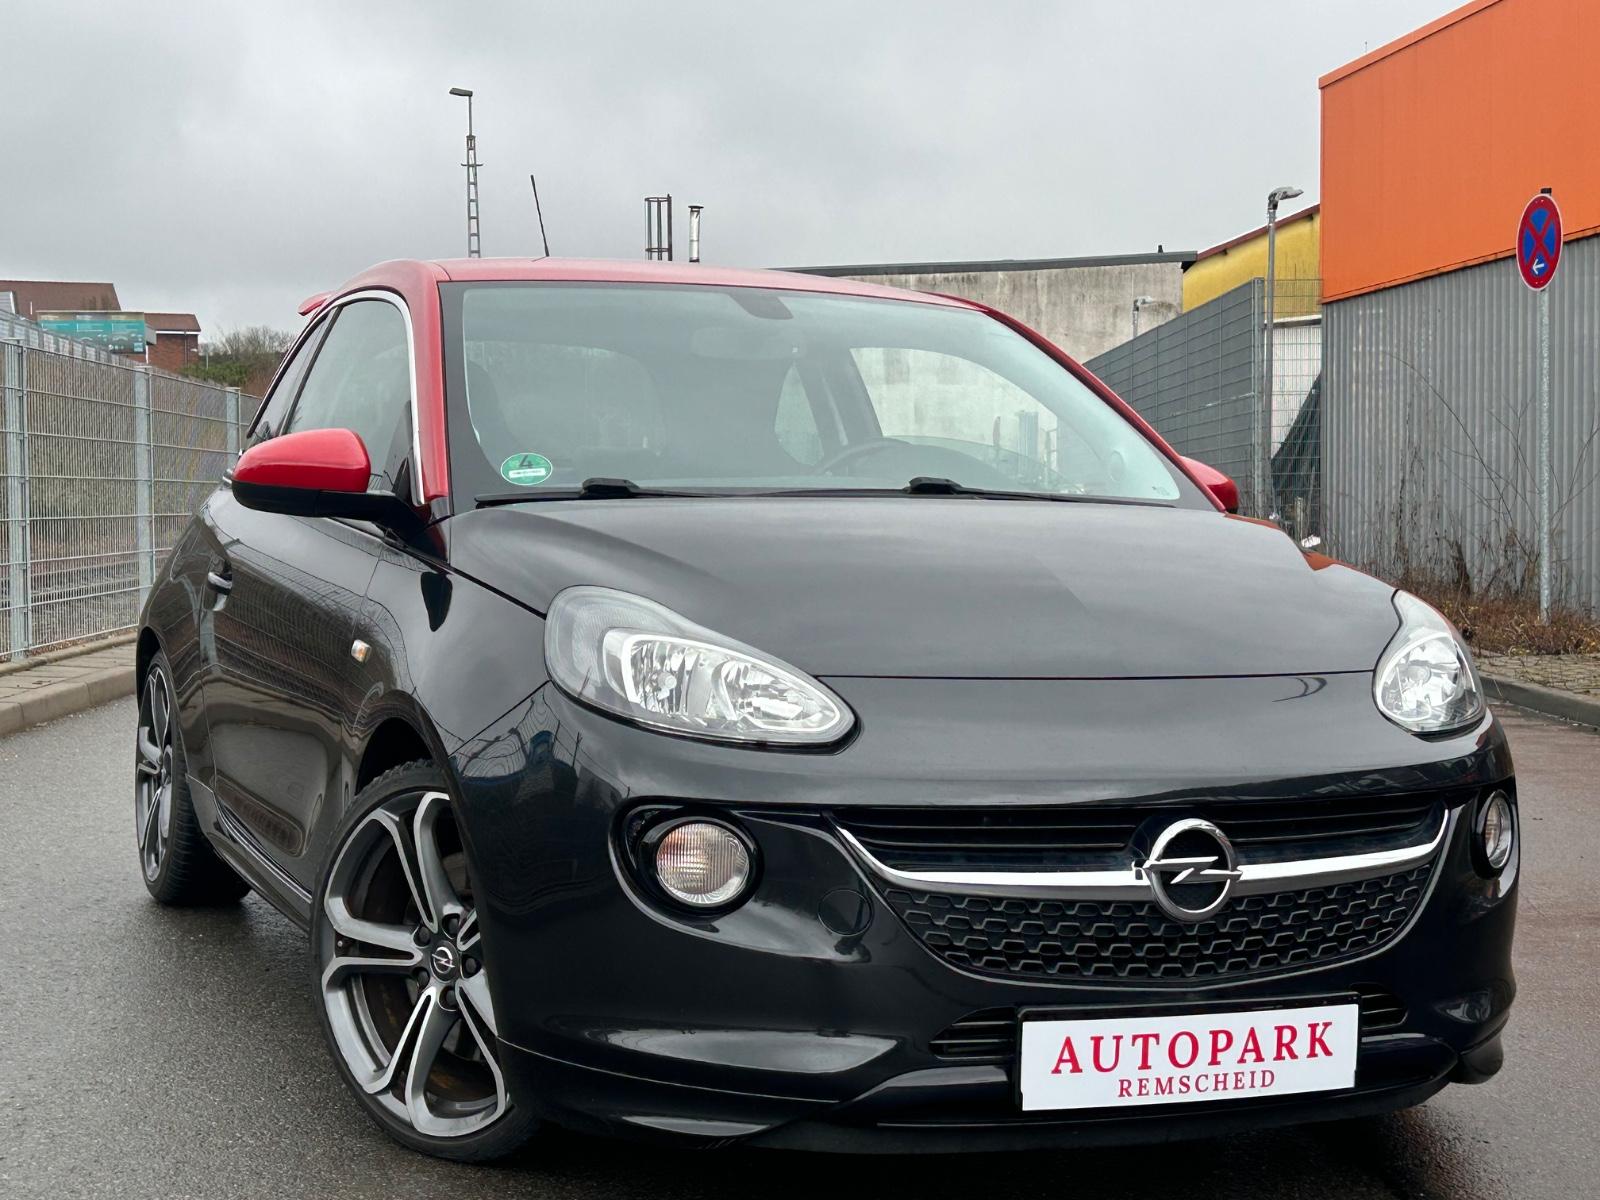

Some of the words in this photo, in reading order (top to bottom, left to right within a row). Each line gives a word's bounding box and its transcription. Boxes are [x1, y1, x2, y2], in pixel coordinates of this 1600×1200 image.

[519, 454, 534, 469] 4
[1051, 1021, 1333, 1074] AUTOPARK
[1118, 1069, 1275, 1098] REMSCHEID
